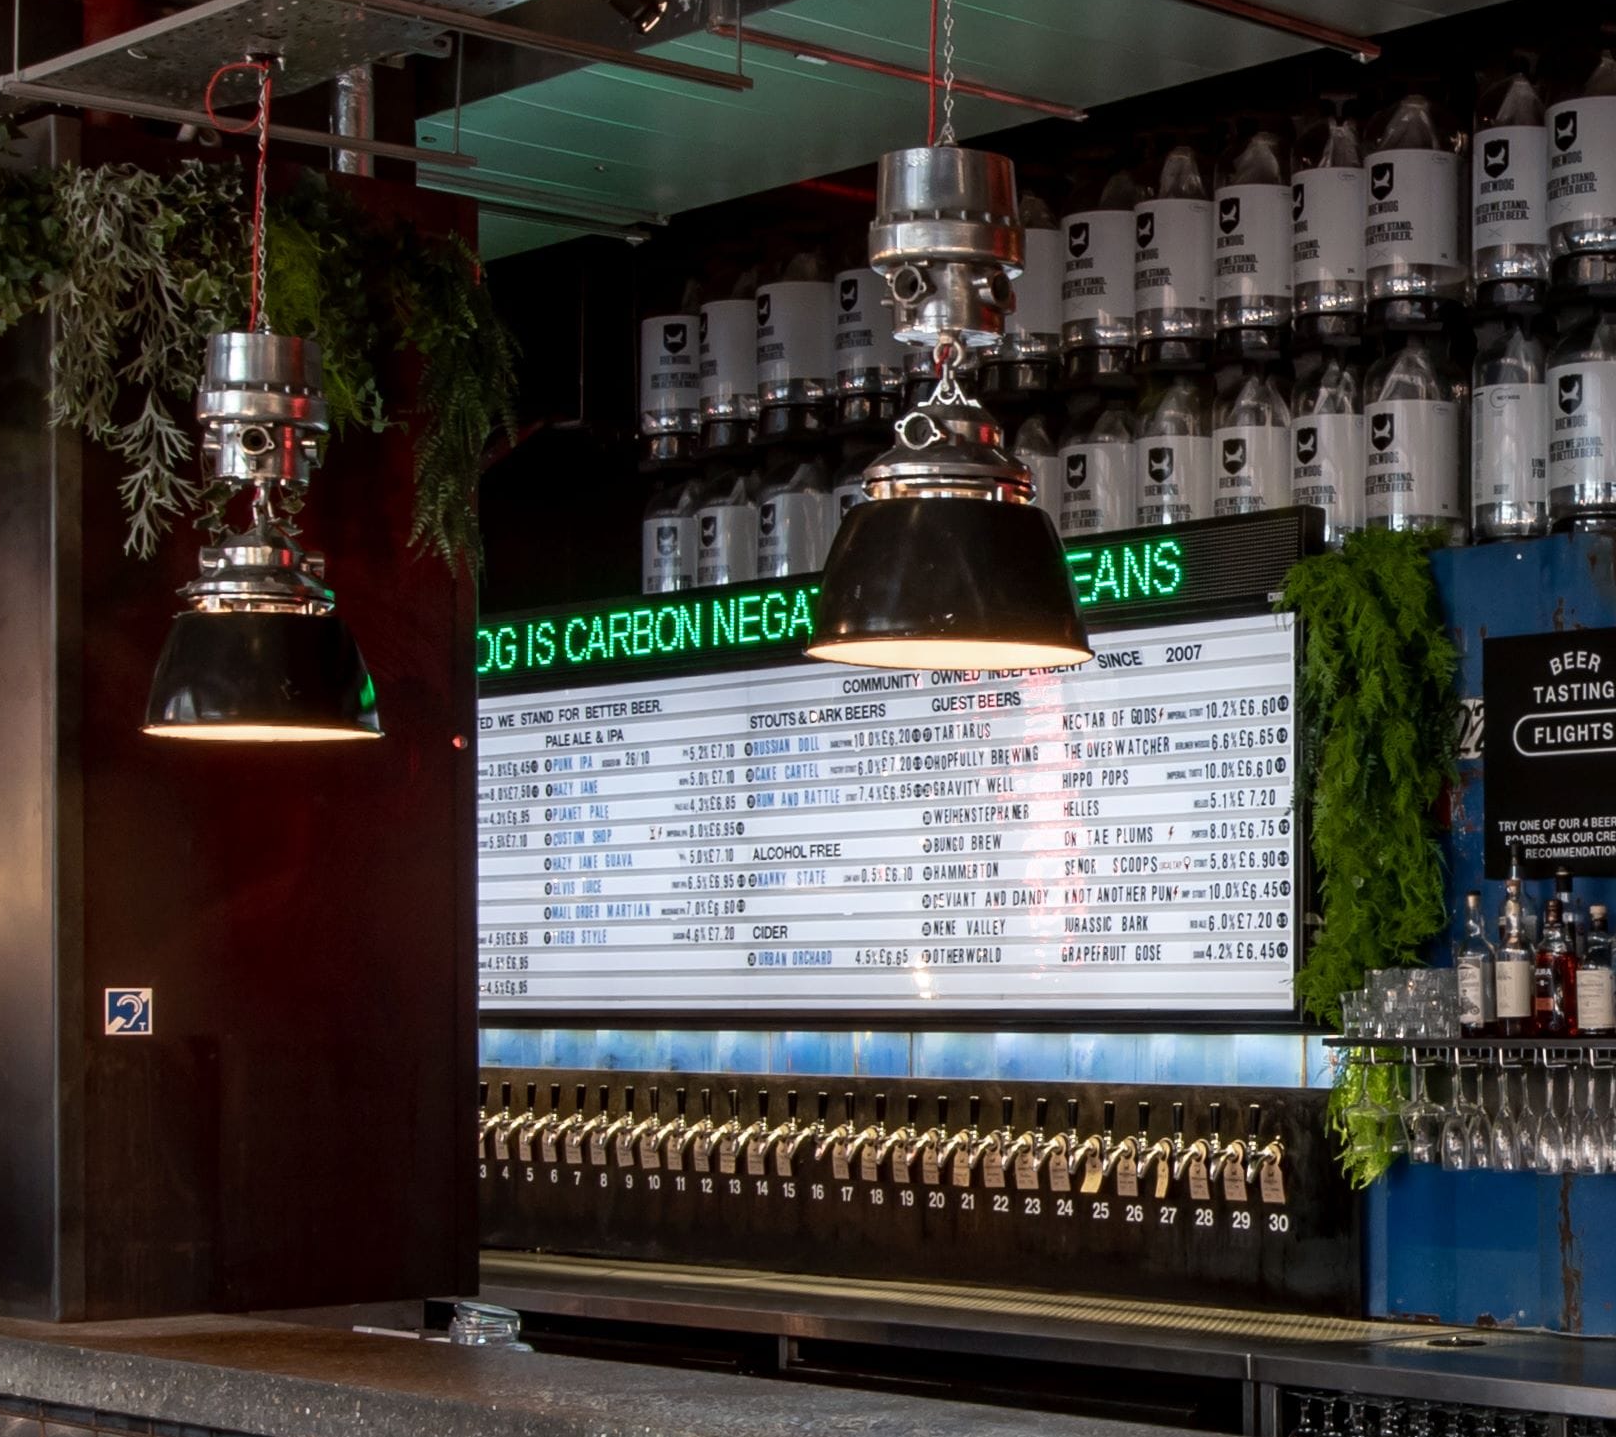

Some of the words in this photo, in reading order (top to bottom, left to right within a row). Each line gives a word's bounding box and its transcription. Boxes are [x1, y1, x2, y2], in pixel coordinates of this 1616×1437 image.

[526, 622, 555, 668] IS
[564, 603, 704, 662] CARBON
[712, 588, 822, 646] NEGA
[843, 674, 920, 693] COMMUNITY
[931, 669, 980, 685] OWNED
[1098, 651, 1142, 669] SINCE
[1166, 645, 1202, 662] 2007
[1549, 651, 1602, 676] BEER
[932, 696, 976, 712] GUEST
[978, 691, 1021, 708] BEERS
[1533, 681, 1615, 704] TASTING
[499, 715, 514, 727] WE
[521, 710, 554, 725] STAND
[558, 707, 579, 721] FOR
[586, 702, 627, 719] BETTER
[631, 699, 662, 715] BEER.
[1240, 697, 1275, 715] £6.60
[750, 712, 796, 729] STOUTS
[799, 712, 807, 725] &
[809, 707, 842, 723] DARK
[845, 703, 886, 720] BEERS
[1063, 712, 1105, 731] NECTAR
[1112, 710, 1124, 726] OF
[1131, 707, 1157, 725] GODS
[545, 733, 570, 748] PALE
[573, 731, 591, 745] ALE
[596, 731, 603, 743] &
[607, 729, 624, 742] IPA
[935, 723, 991, 741] TARTARUS
[1534, 722, 1614, 745] FLIGHTS
[753, 738, 790, 754] RUSSIAN
[799, 736, 819, 752] DOLL
[1065, 742, 1081, 759] THE
[1087, 736, 1170, 759] OVERWATCHER
[935, 752, 984, 769] HOPFULLY
[991, 745, 1039, 766] BREWING
[755, 765, 776, 781] CAKE
[785, 763, 819, 779] CARTEL
[1063, 772, 1093, 789] HIPPO
[1102, 769, 1128, 786] POPS
[934, 778, 980, 795] GRAVITY
[987, 777, 1014, 793] WELL
[1064, 800, 1099, 817] HELLES
[1498, 820, 1518, 832] TRY
[1520, 819, 1540, 831] ONE
[1542, 818, 1557, 830] OF
[1558, 817, 1580, 829] OUR
[1583, 817, 1589, 828] 4
[971, 835, 1001, 850] BREW
[1087, 828, 1109, 844] TAE
[1116, 827, 1153, 844] PLUMS
[1550, 832, 1570, 844] ASK
[1572, 831, 1594, 843] OUR
[753, 845, 807, 860] ALCOHOL
[810, 843, 841, 858] FREE
[934, 862, 999, 880] HAMMERTON
[1113, 856, 1158, 874] SCOOPS
[797, 870, 826, 885] STATE
[985, 890, 1006, 907] AND
[1012, 889, 1049, 905] DANDY
[1064, 888, 1091, 904] KNOT
[1097, 885, 1146, 903] ANOTHER
[1152, 884, 1172, 901] PUN
[753, 925, 788, 939] CIDER
[934, 920, 956, 936] NENE
[967, 919, 1005, 935] VALLEY
[1064, 916, 1112, 934] JURASSIC
[1122, 915, 1148, 932] BARK
[1062, 945, 1126, 962] GRAPEFRUIT
[1135, 944, 1161, 961] GOSE
[1057, 1199, 1073, 1216] 24
[1092, 1202, 1109, 1219] 25
[1126, 1205, 1144, 1222] 26
[1160, 1206, 1177, 1224] 27
[1196, 1208, 1213, 1227] 28
[1232, 1211, 1251, 1229] 29
[1269, 1214, 1289, 1232] 30
